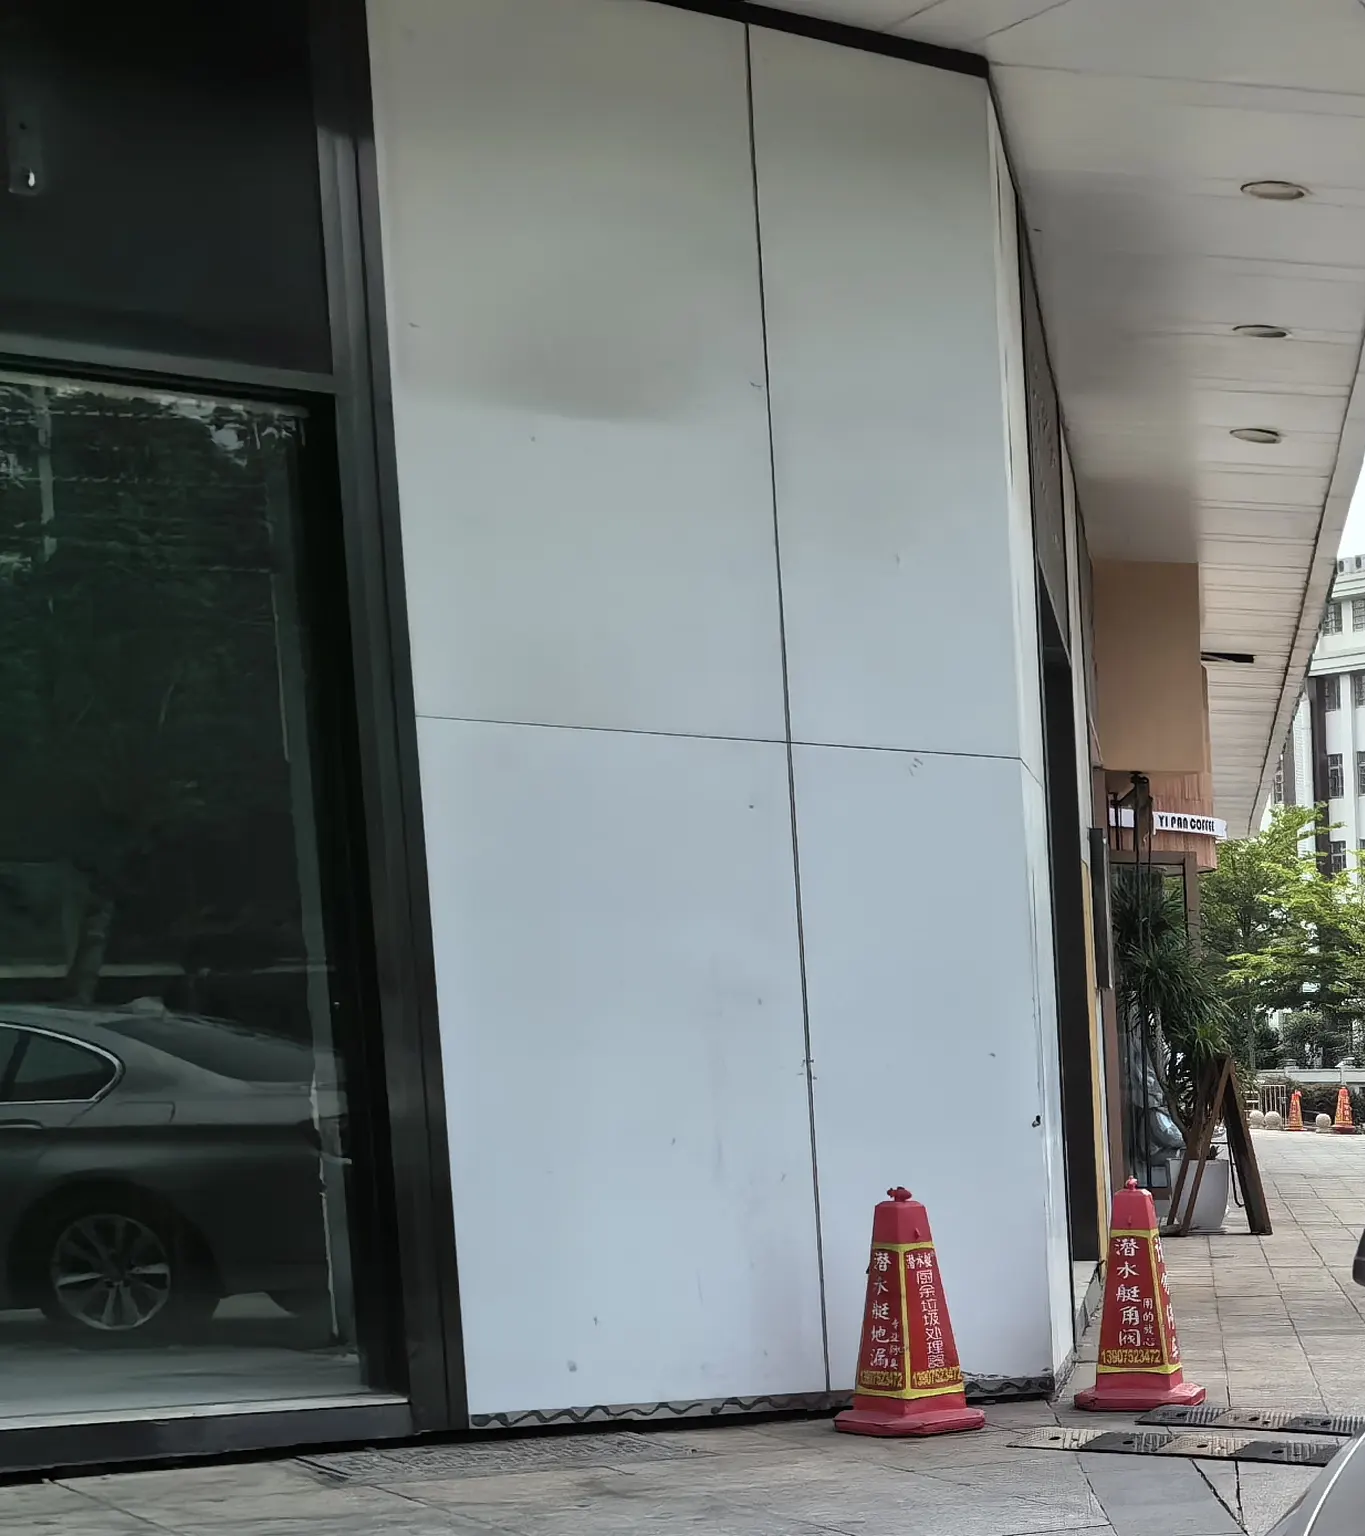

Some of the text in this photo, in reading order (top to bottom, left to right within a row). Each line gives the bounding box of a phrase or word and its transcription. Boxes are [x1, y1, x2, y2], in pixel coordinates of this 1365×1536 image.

[1190, 817, 1215, 832] COFFEE
[870, 1251, 892, 1370] 潜水艇地漏
[916, 1269, 945, 1369] 厨余垃圾处理器
